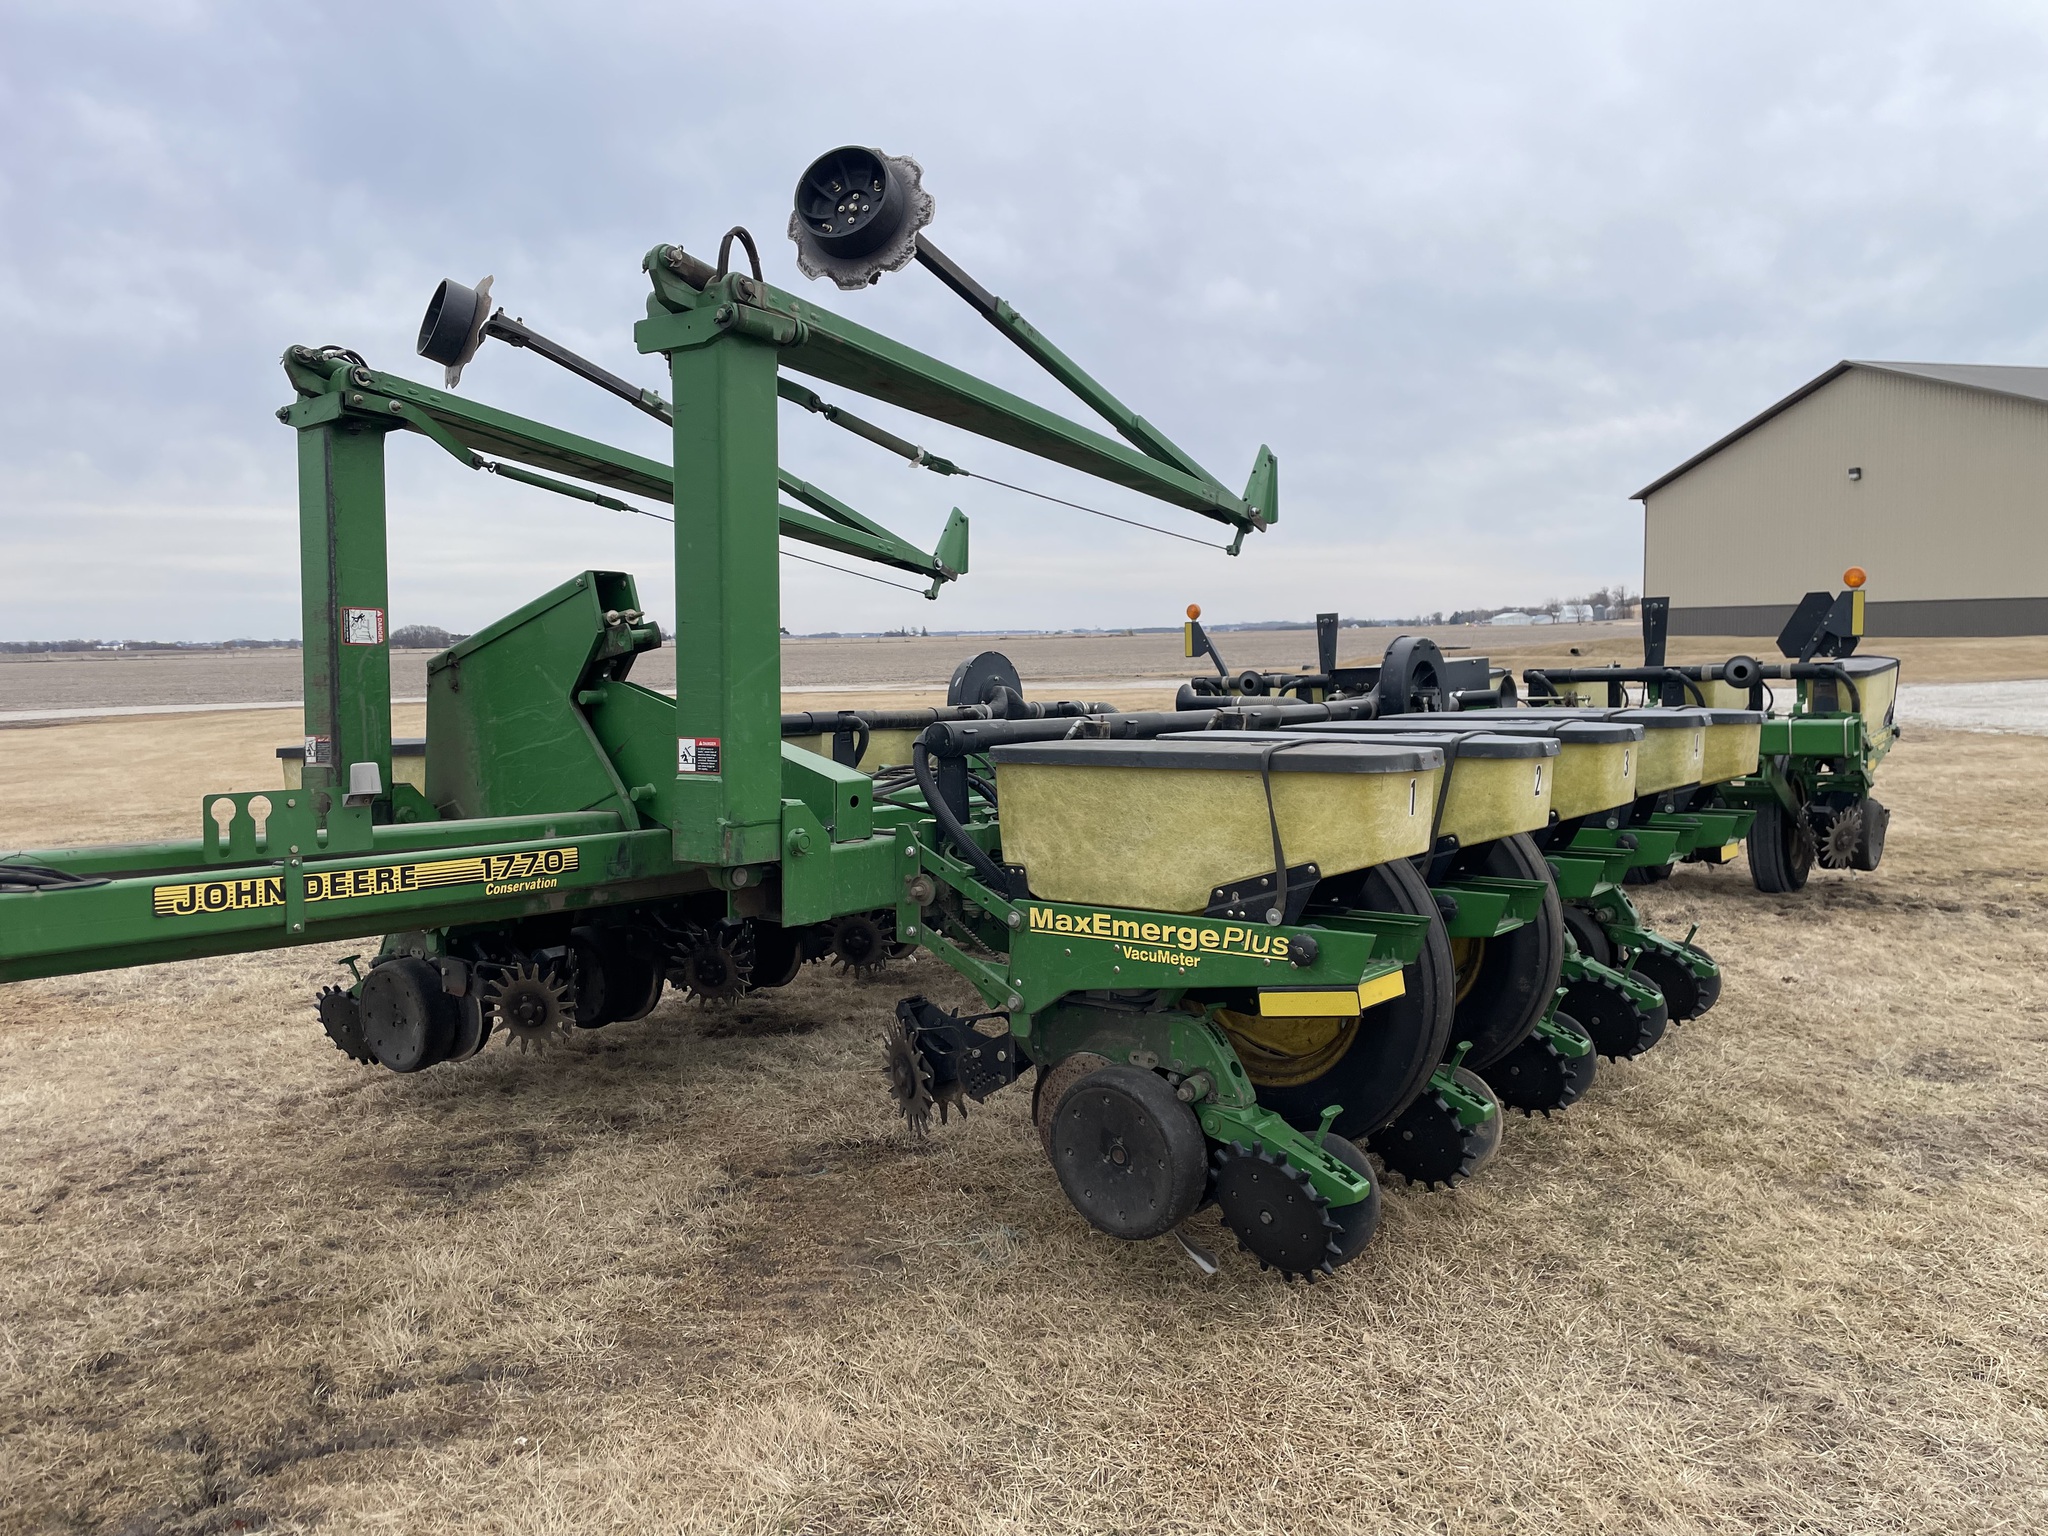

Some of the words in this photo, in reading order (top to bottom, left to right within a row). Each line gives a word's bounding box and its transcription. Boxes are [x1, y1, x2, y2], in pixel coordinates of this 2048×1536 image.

[1623, 749, 1631, 778] 3
[1534, 764, 1543, 798] 2
[1409, 778, 1417, 816] 1
[173, 877, 287, 915] JOHN
[303, 865, 419, 902] DEERE
[479, 849, 566, 881] 1770
[485, 876, 558, 896] Conservation
[1122, 945, 1201, 968] VacuMeter
